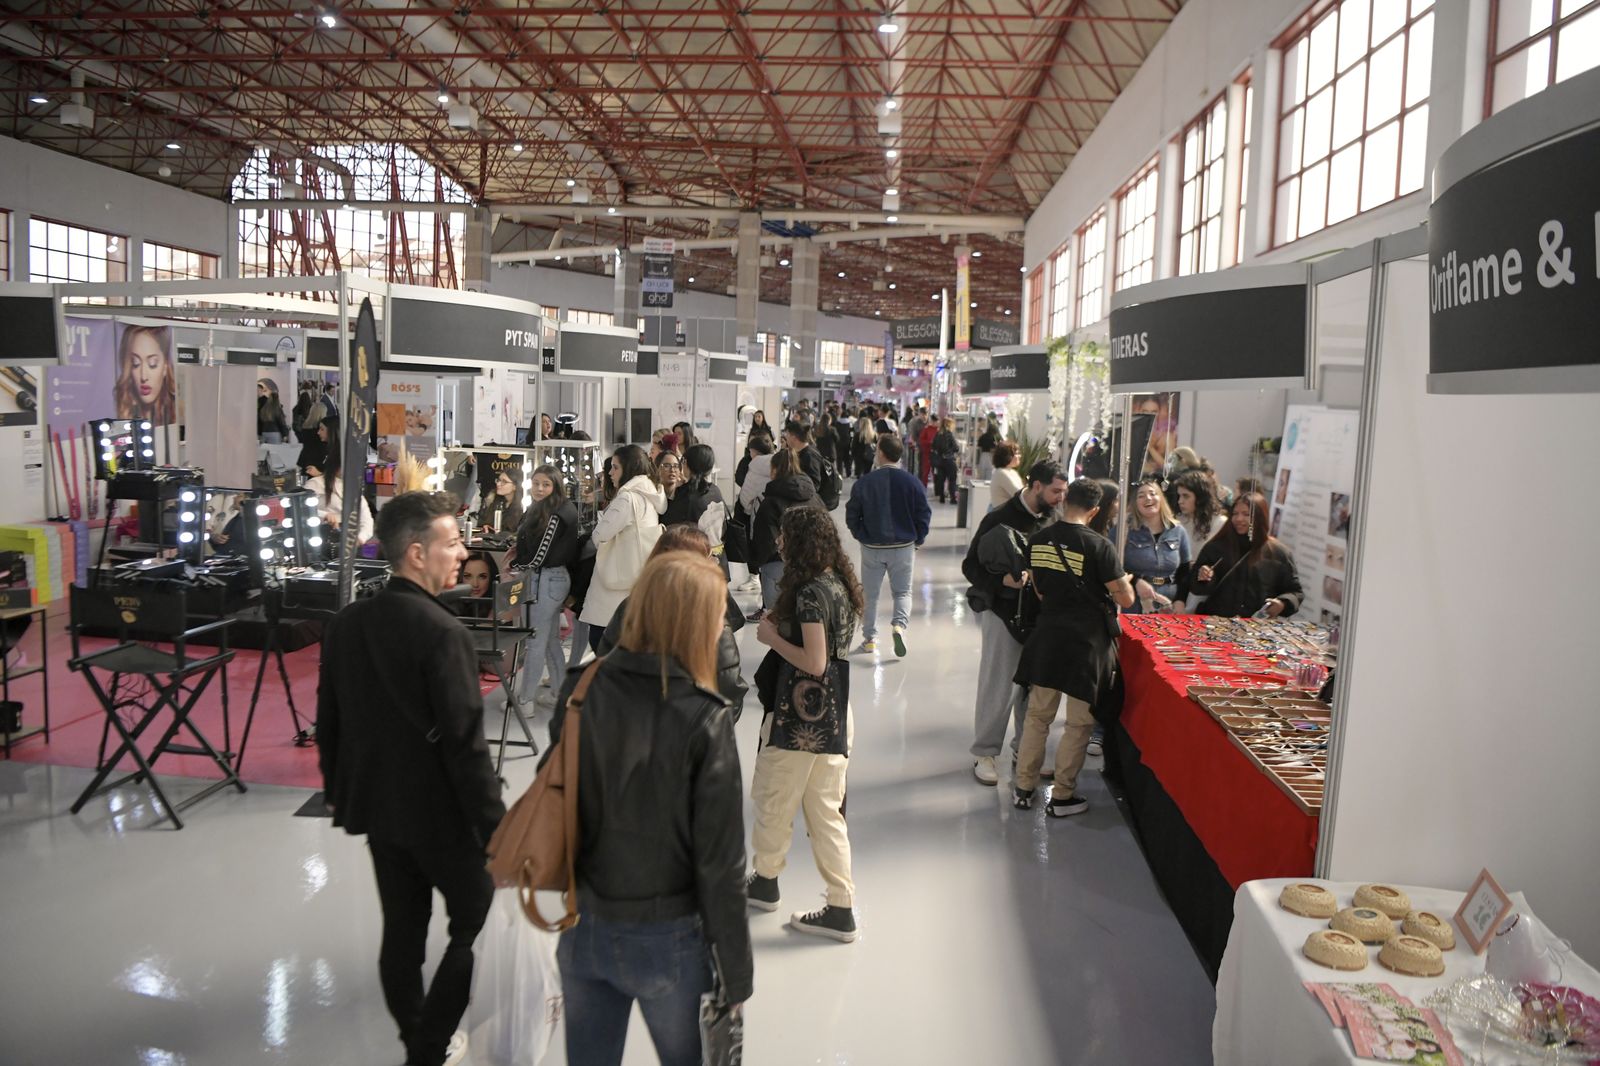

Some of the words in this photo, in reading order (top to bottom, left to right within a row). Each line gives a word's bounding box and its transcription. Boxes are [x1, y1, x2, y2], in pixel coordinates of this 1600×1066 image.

[1431, 248, 1523, 314] Oriflame
[1536, 219, 1576, 289] &
[505, 328, 523, 347] PYT
[896, 323, 941, 339] BLESSON
